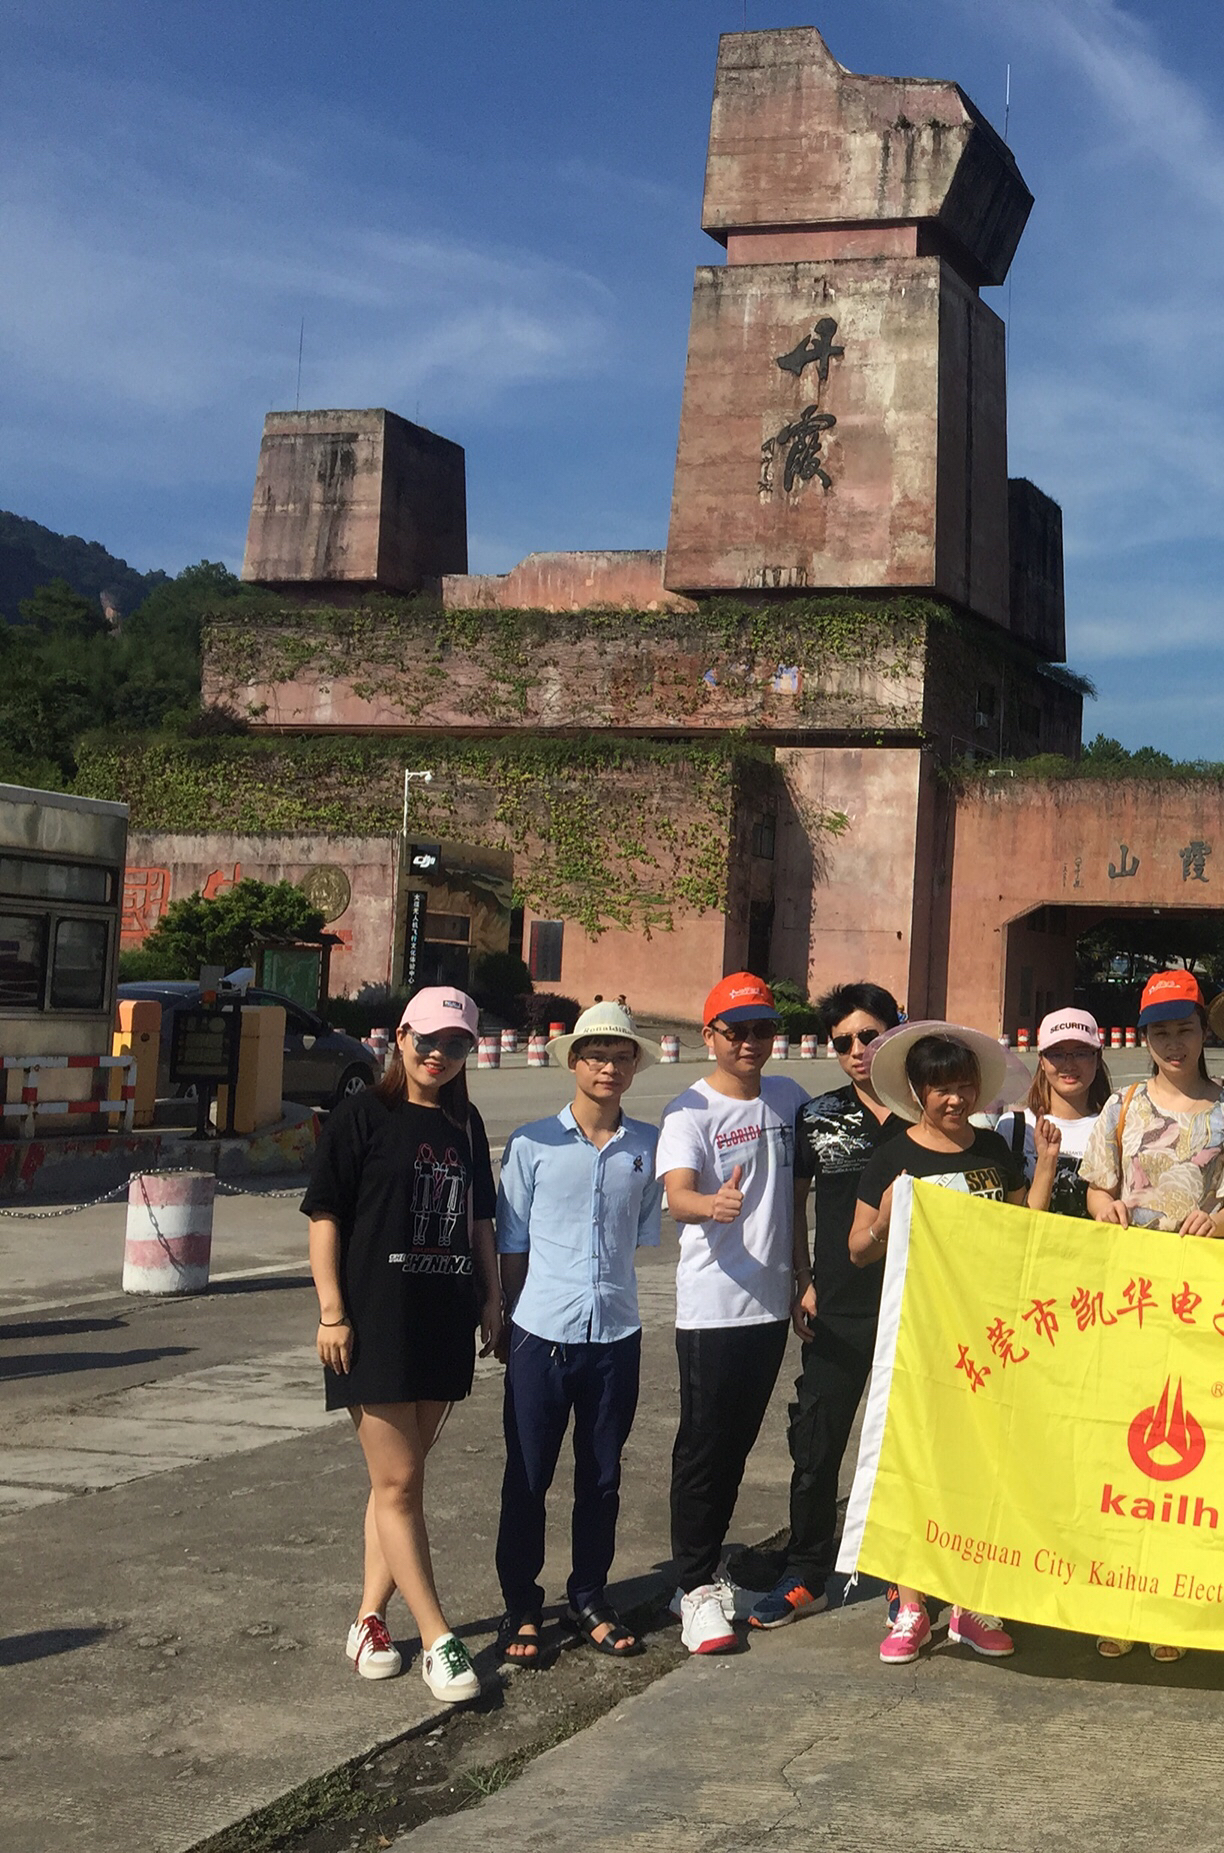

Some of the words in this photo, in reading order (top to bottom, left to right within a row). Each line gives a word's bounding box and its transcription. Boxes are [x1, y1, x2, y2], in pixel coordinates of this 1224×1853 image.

[716, 1124, 762, 1149] FLORIDA
[966, 1168, 1000, 1191] SPO
[1100, 1483, 1219, 1529] kailh
[925, 1518, 1022, 1568] Dongguan
[1033, 1548, 1076, 1586] City
[1088, 1560, 1160, 1596] Kaihua
